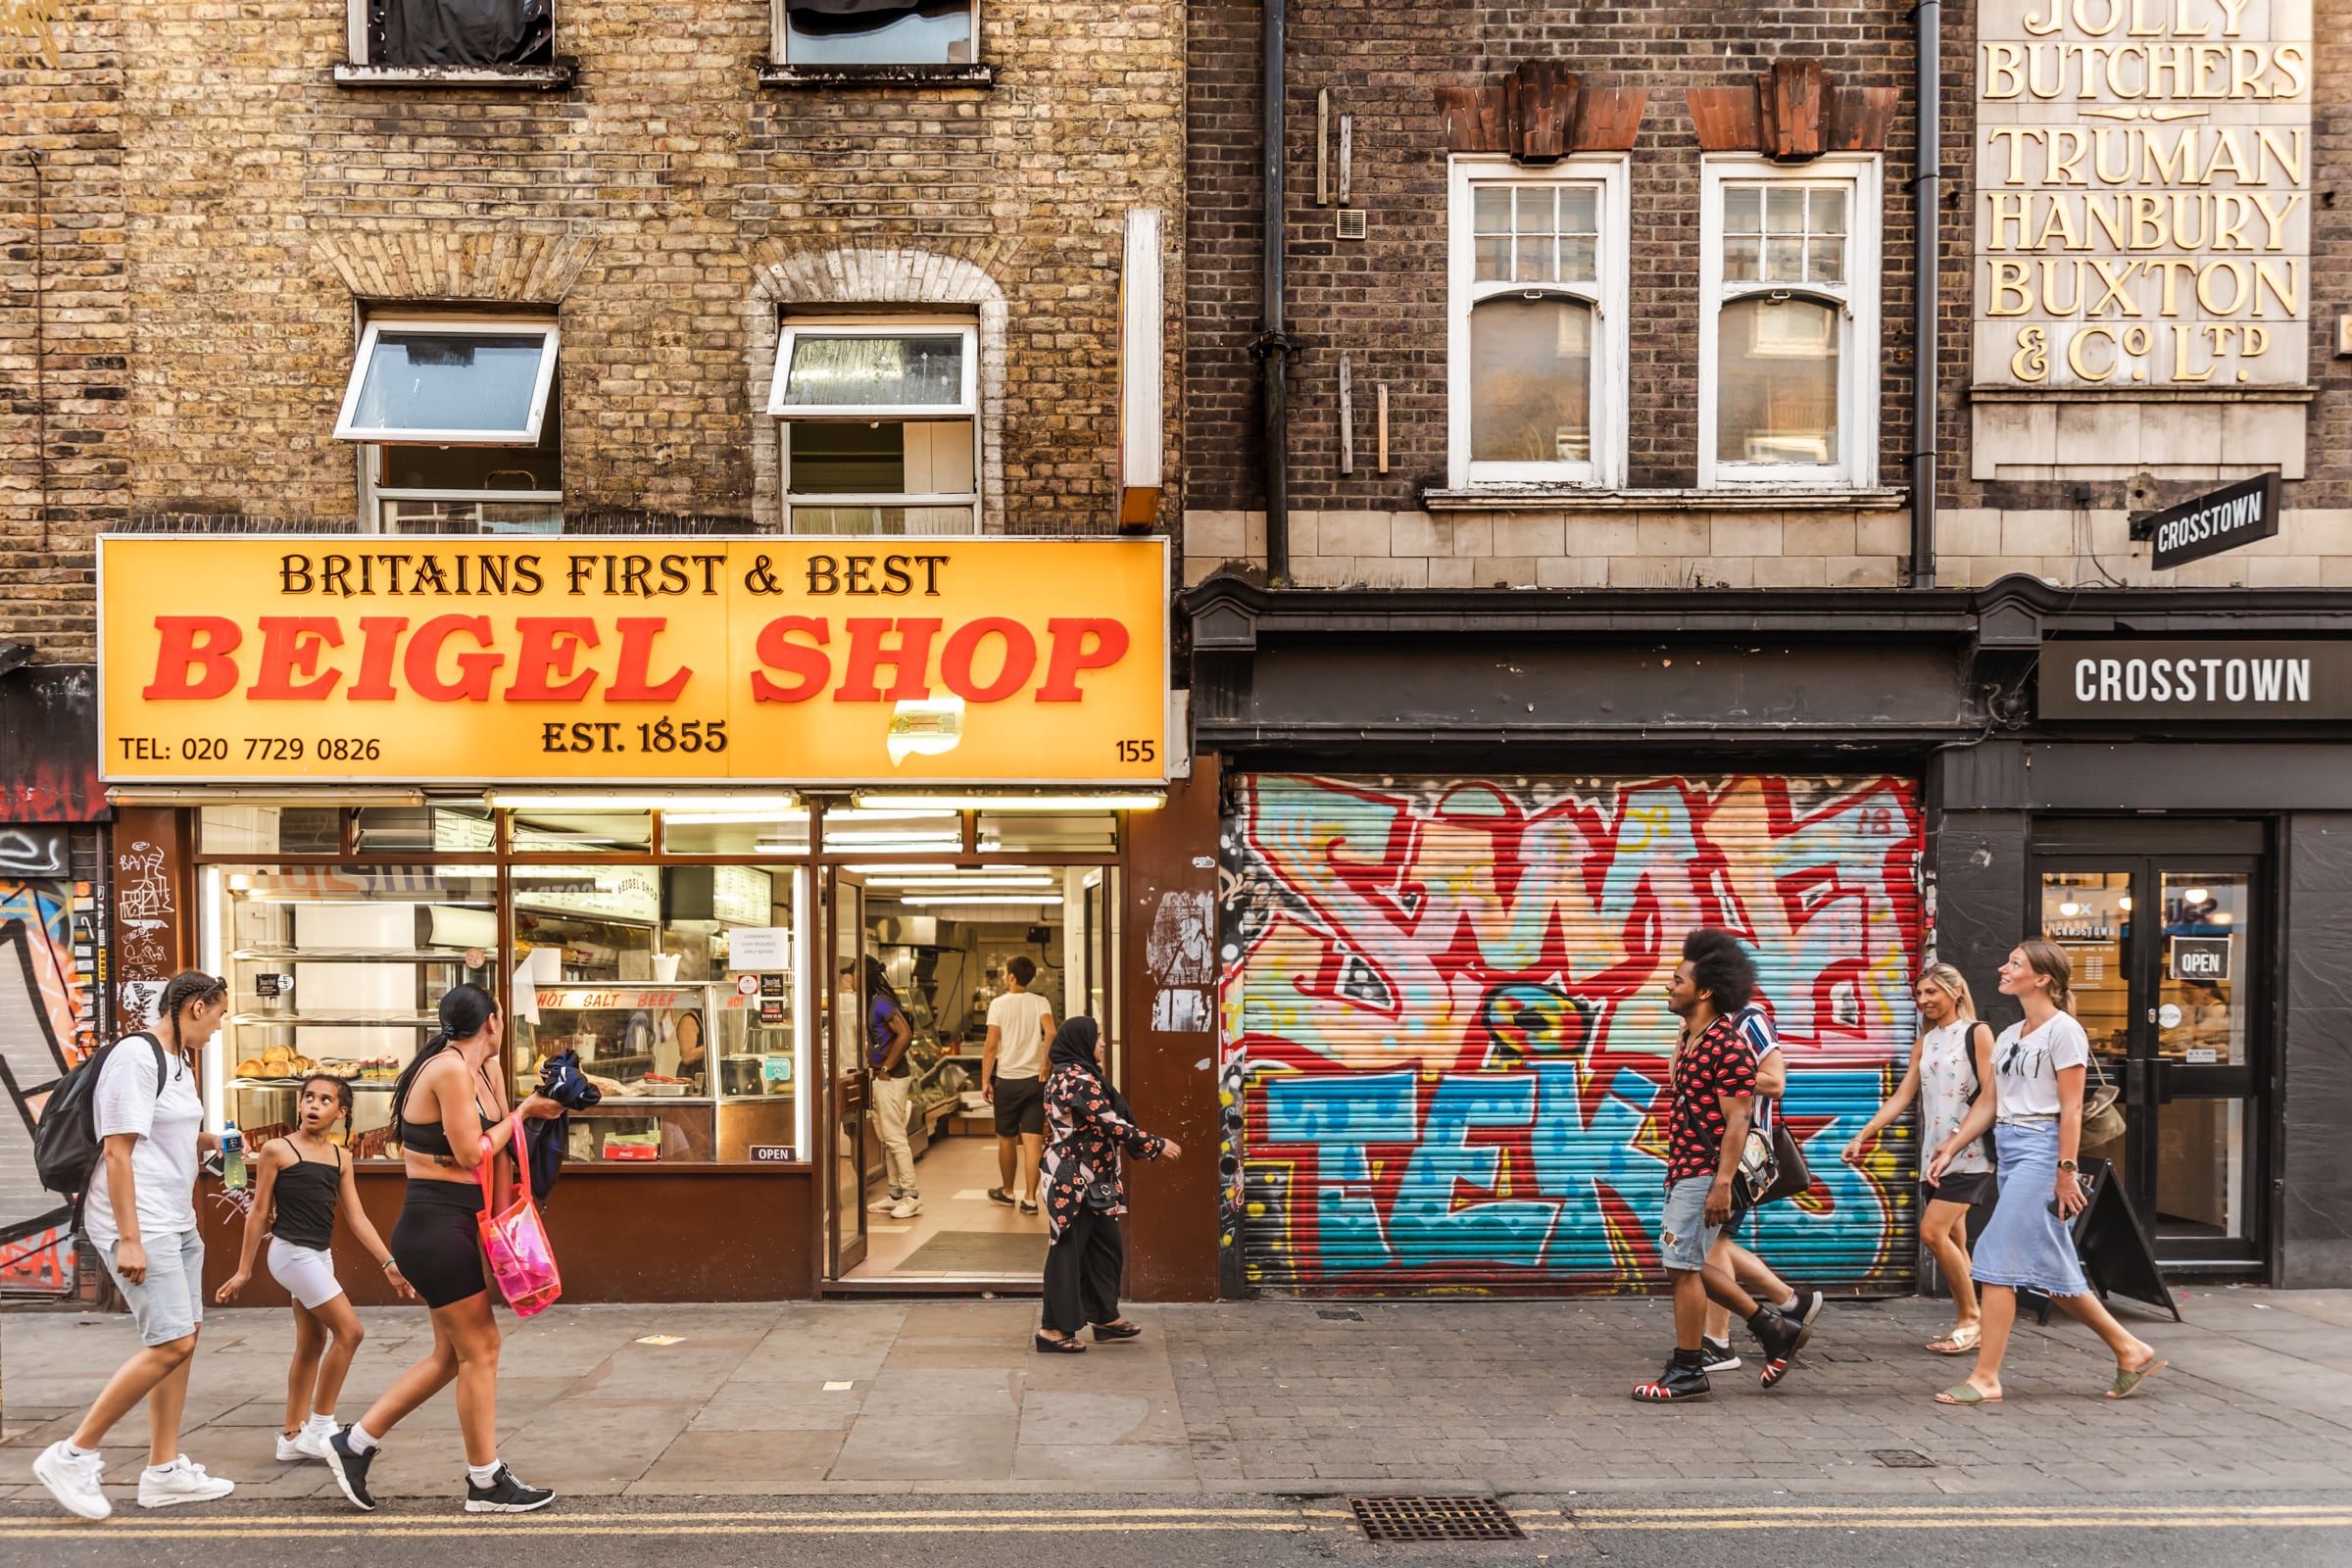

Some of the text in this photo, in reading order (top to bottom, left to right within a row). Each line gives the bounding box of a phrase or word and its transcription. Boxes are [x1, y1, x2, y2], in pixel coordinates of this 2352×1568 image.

[2023, 0, 2249, 37] JOLLY
[1984, 43, 2307, 100] BUTCHERS
[1988, 126, 2304, 186] TRUMAN
[1987, 193, 2302, 252] HANBURY
[1986, 259, 2299, 318] BUXTON
[2010, 325, 2049, 382] &
[2157, 490, 2262, 554] CROSSTOWN
[280, 554, 951, 599] BRITAINS FIRST & BEST
[141, 613, 1130, 703] BEIGEL SHOP
[2075, 658, 2310, 702] CROSSTOWN
[119, 737, 380, 760] TEL: 020 7729 0826
[543, 715, 728, 754] EST. 1855
[1115, 739, 1155, 762] 155
[617, 877, 641, 895] BEIGEL
[641, 880, 659, 902] SHOP
[2055, 925, 2116, 937] CROSSTOWN
[2181, 953, 2220, 972] OPEN
[537, 993, 677, 1007] HOT SALT BEEF
[727, 997, 747, 1007] HOT
[759, 1149, 789, 1159] OPEN
